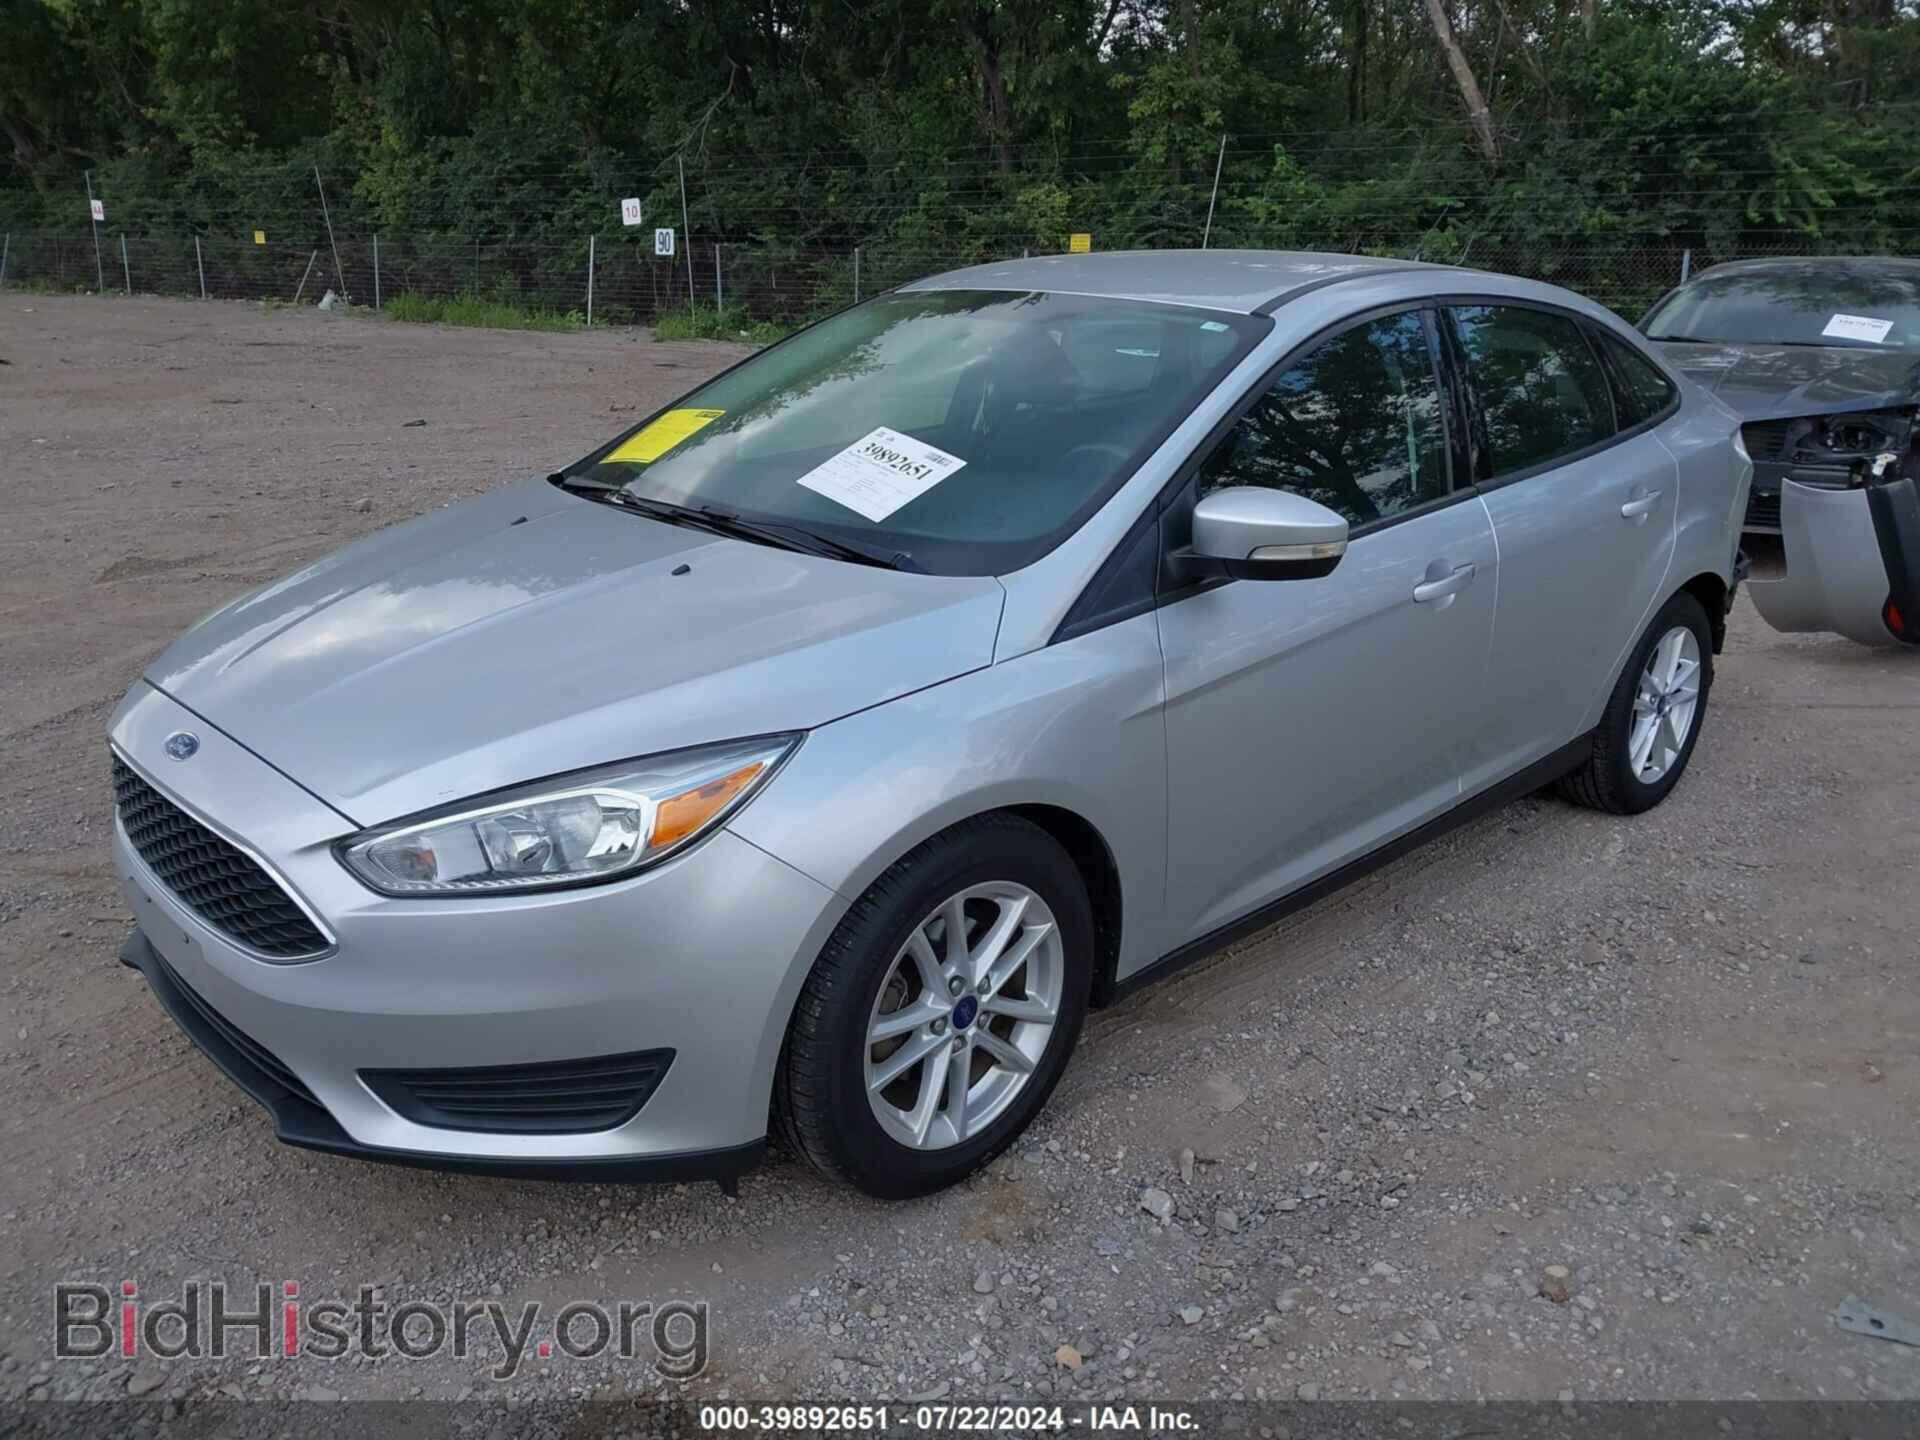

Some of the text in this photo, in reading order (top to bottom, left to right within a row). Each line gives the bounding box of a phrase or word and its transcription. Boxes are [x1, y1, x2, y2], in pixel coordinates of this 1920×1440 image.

[625, 206, 638, 218] 10
[658, 231, 671, 252] 90
[857, 442, 933, 480] 39892651
